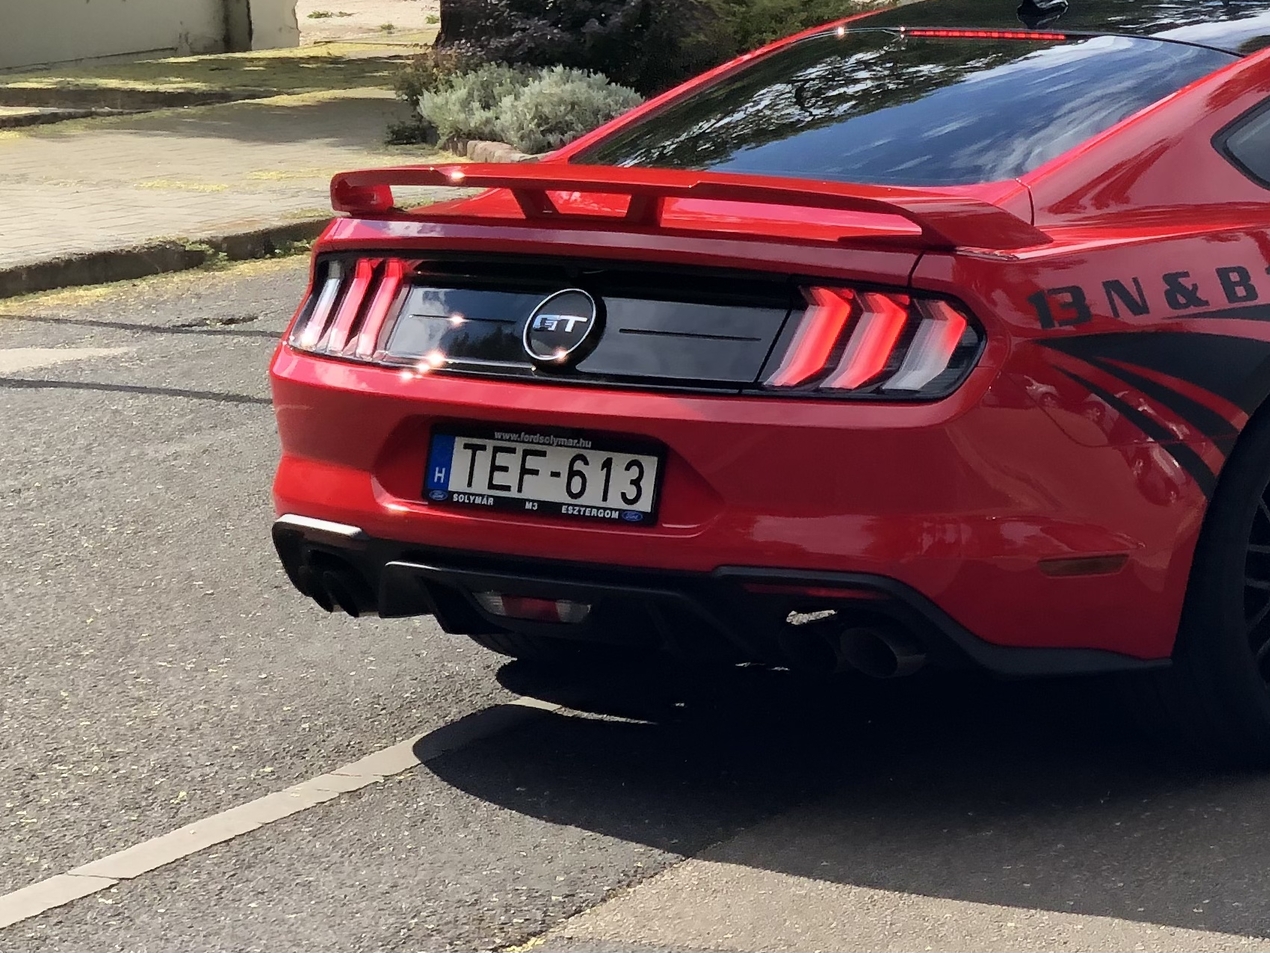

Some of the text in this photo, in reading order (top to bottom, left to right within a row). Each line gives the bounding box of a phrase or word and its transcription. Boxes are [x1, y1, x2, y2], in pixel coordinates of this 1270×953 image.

[1026, 285, 1093, 330] 13
[1102, 277, 1149, 318] N
[1162, 271, 1210, 310] &
[1215, 266, 1259, 303] B
[532, 314, 588, 332] GT
[494, 431, 592, 448] www.fordsolymar.hu
[434, 466, 446, 483] H
[463, 443, 645, 505] TEF-613
[452, 493, 494, 506] SOLYMÁR
[525, 501, 538, 510] M3
[561, 505, 619, 519] ESZTERGOM
